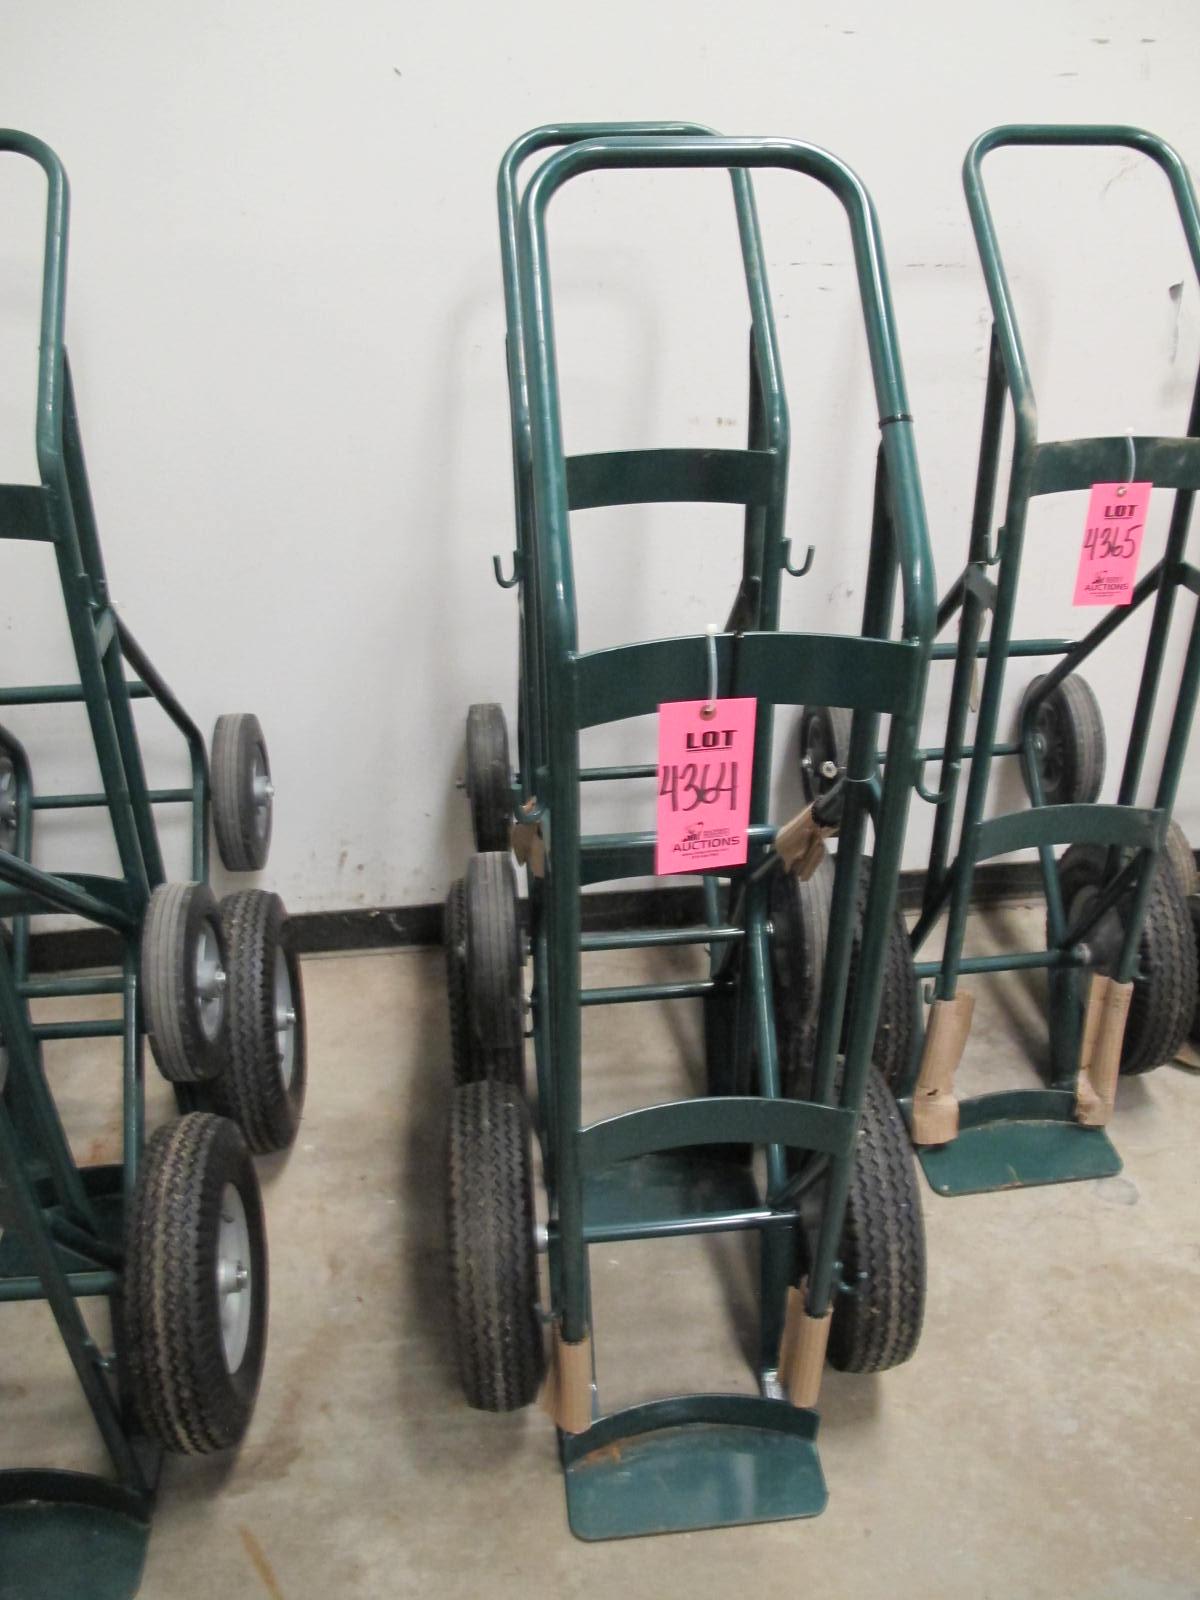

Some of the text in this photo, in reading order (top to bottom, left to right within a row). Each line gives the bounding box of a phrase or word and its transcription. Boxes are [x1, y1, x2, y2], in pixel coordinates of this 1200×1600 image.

[1104, 505, 1139, 517] LOT
[1084, 524, 1142, 560] 4365
[1085, 583, 1128, 591] AUCTIONS
[686, 730, 737, 749] LOT
[660, 761, 737, 812] 4364
[673, 836, 740, 852] AUCTIONS
